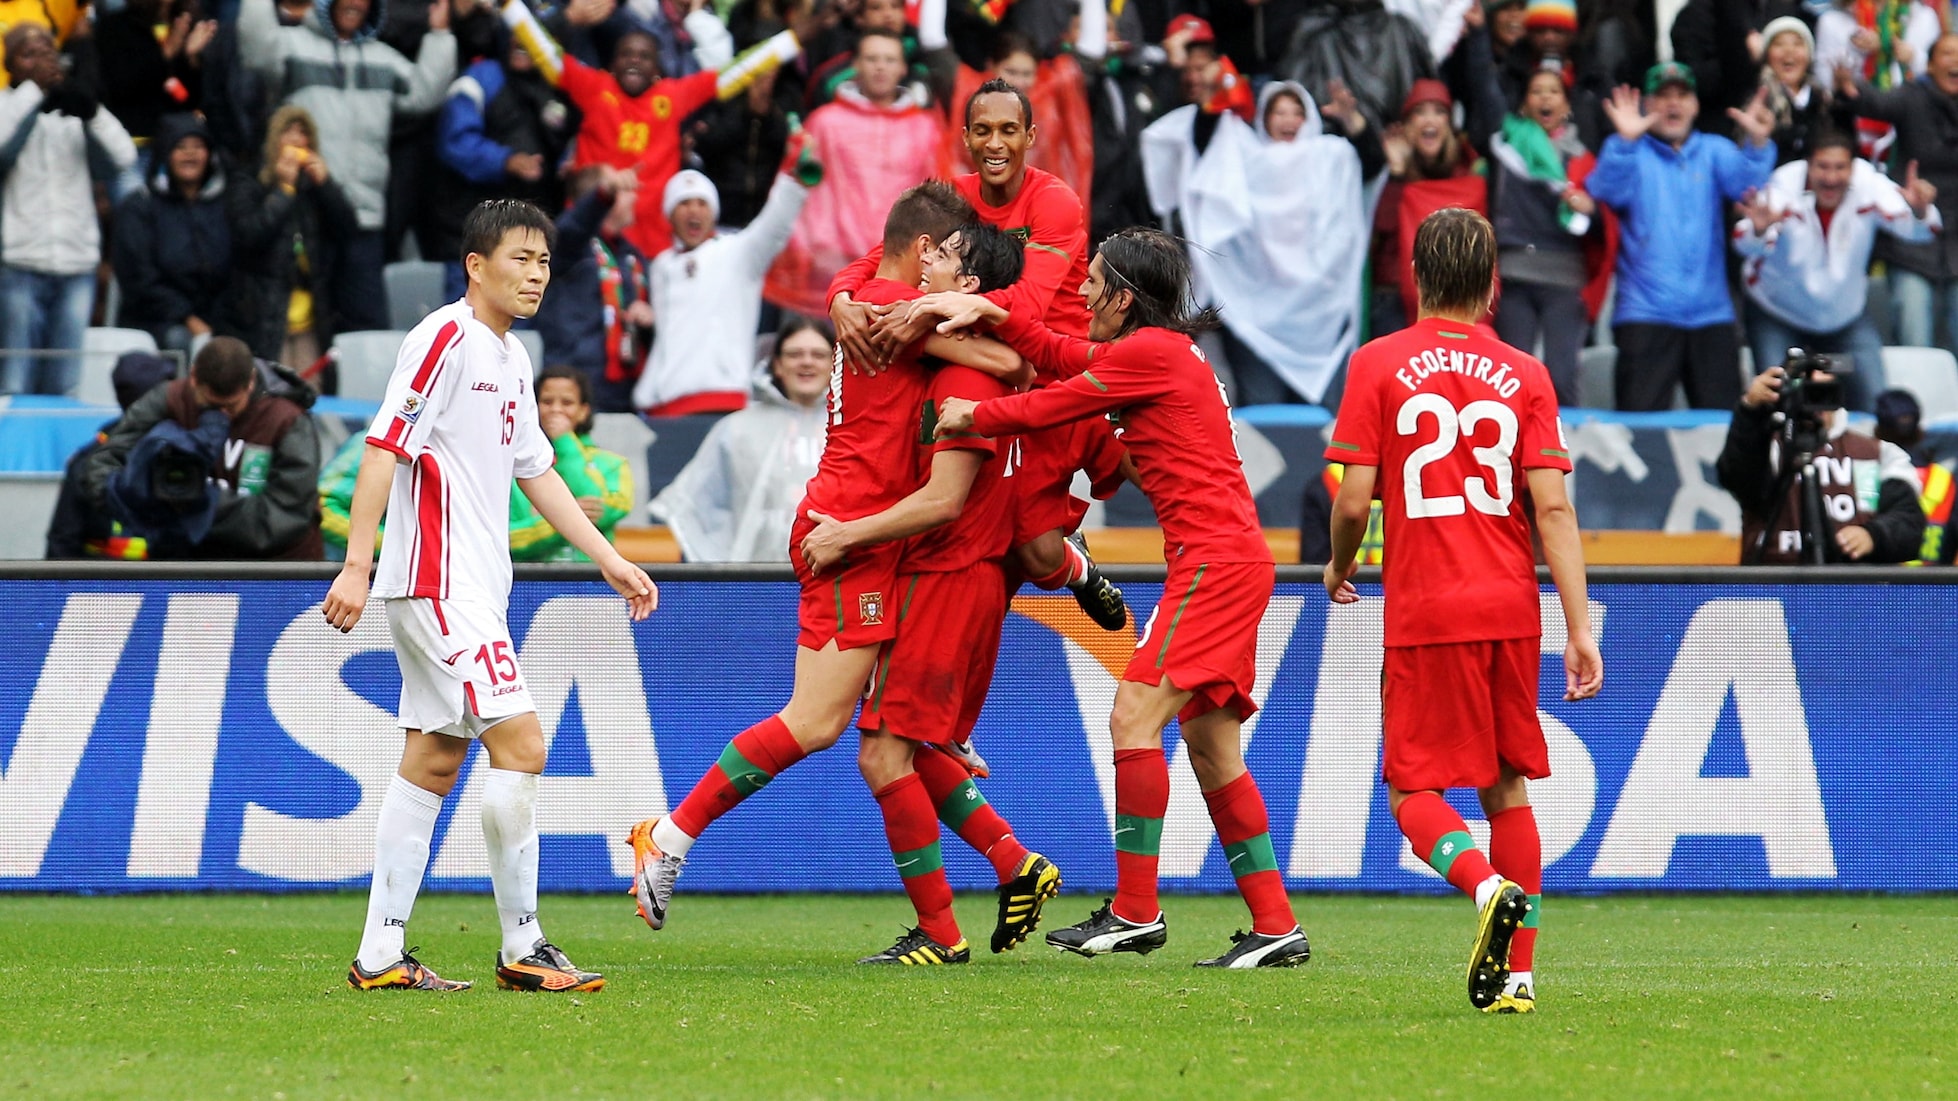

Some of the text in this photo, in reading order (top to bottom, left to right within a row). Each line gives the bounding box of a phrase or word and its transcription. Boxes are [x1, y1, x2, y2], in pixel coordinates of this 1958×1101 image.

[471, 381, 499, 393] LEGEA
[1395, 347, 1521, 399] F.COENTRÃO
[500, 400, 517, 446] 15
[1396, 392, 1519, 519] 23
[474, 641, 517, 685] 15
[492, 684, 523, 697] LEGEA
